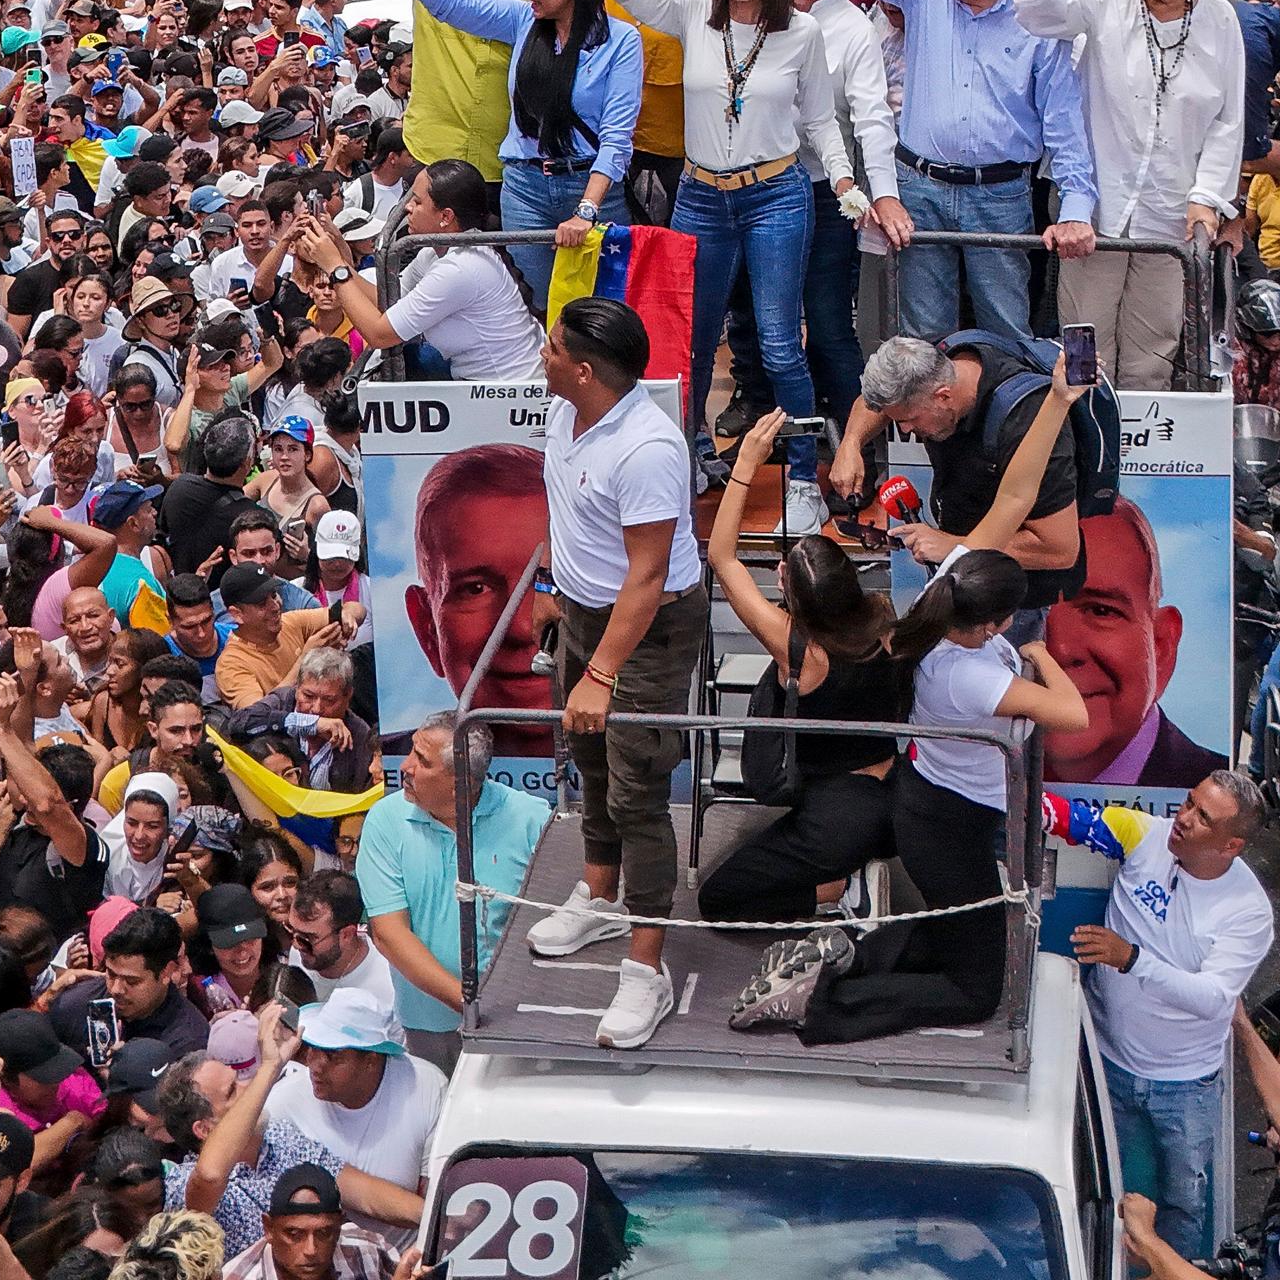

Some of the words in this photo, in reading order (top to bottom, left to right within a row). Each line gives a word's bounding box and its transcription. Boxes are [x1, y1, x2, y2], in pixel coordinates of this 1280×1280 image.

[470, 385, 517, 399] Mesa
[523, 384, 543, 399] de
[360, 400, 451, 435] MUD
[510, 408, 549, 427] Uni
[1121, 428, 1150, 447] ad
[1120, 460, 1204, 474] emocrática
[881, 481, 908, 504] NTN24
[1146, 880, 1171, 907] CON
[444, 1180, 579, 1277] 28
